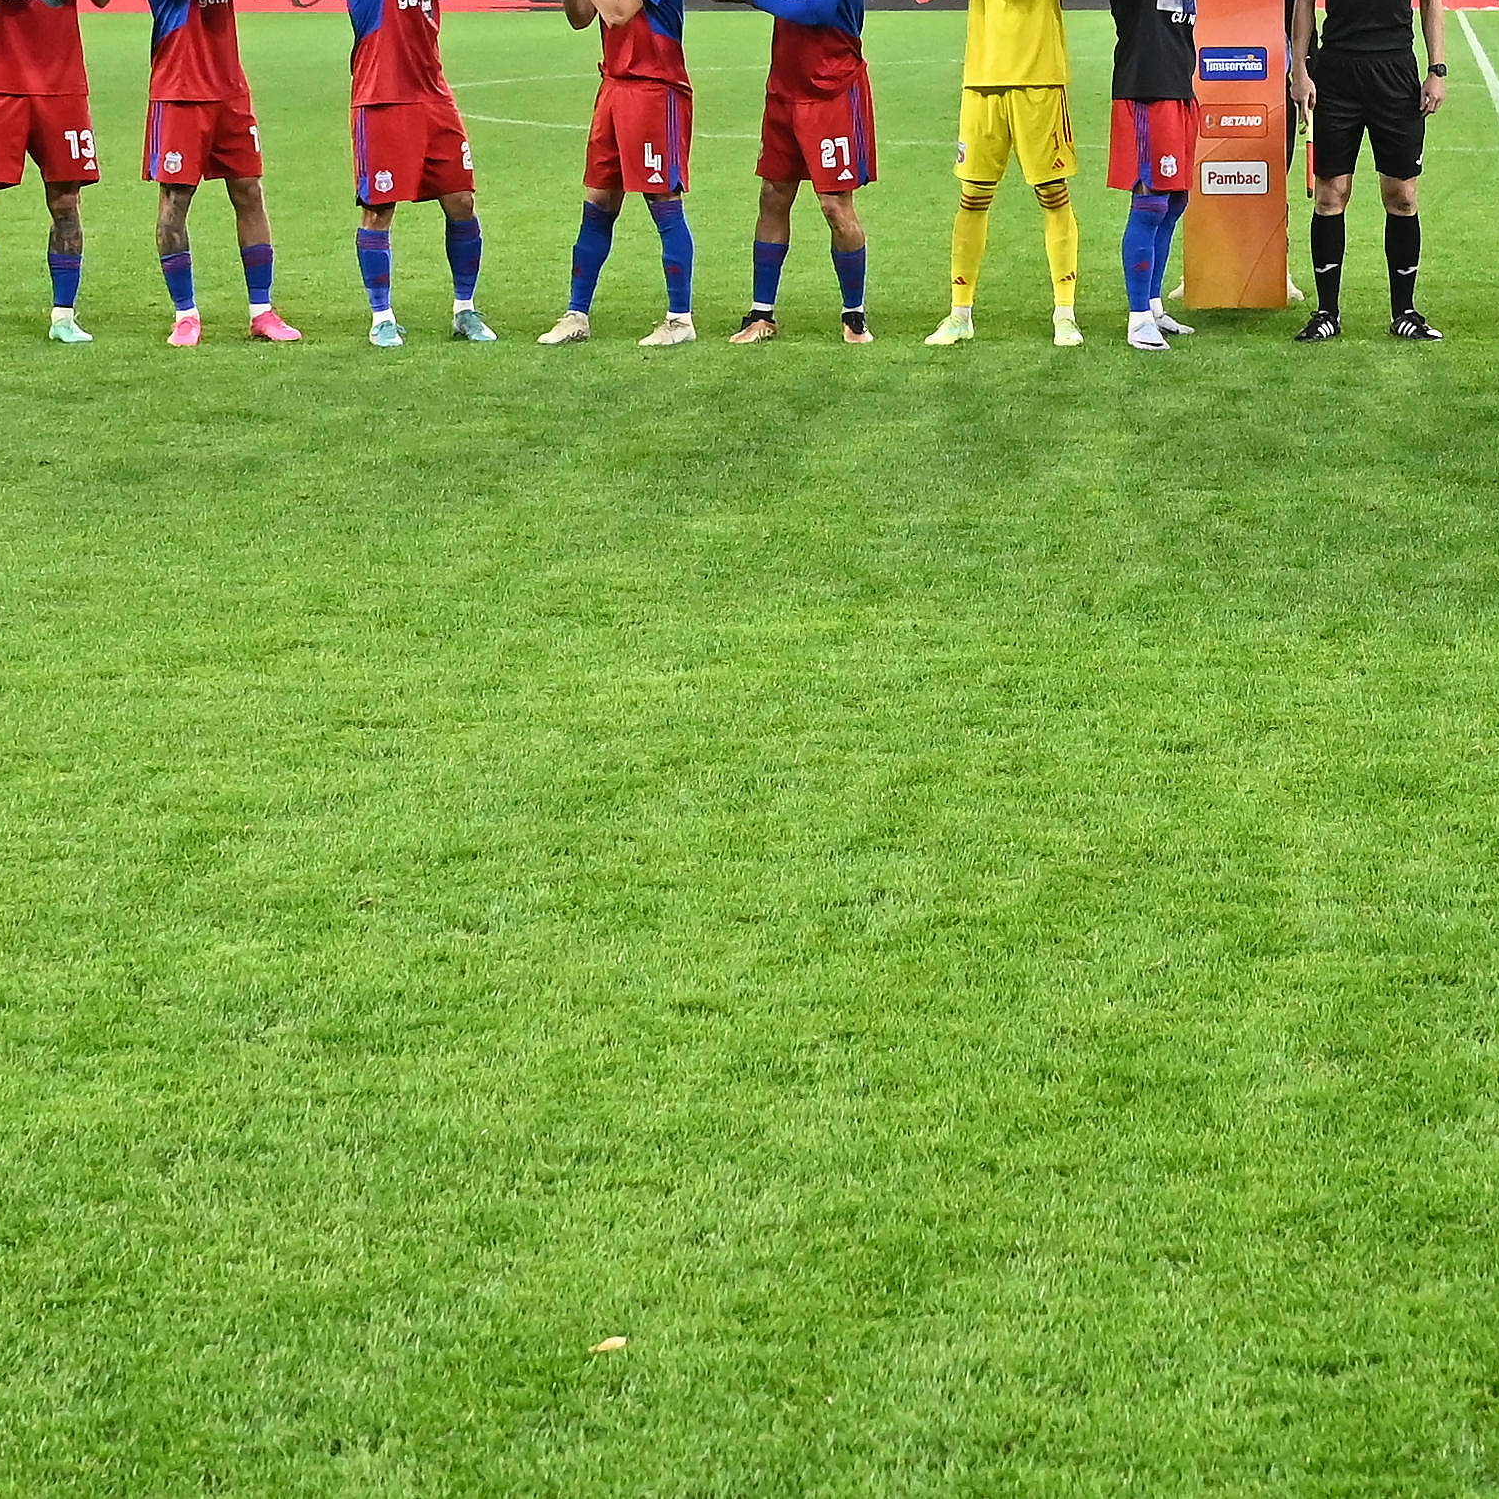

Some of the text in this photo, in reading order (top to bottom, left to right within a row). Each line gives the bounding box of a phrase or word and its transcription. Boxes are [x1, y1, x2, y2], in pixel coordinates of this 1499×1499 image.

[1220, 115, 1263, 127] BETANO
[64, 130, 96, 158] 13
[644, 142, 662, 171] 4
[820, 137, 850, 167] 27
[1207, 170, 1261, 187] Pambac
